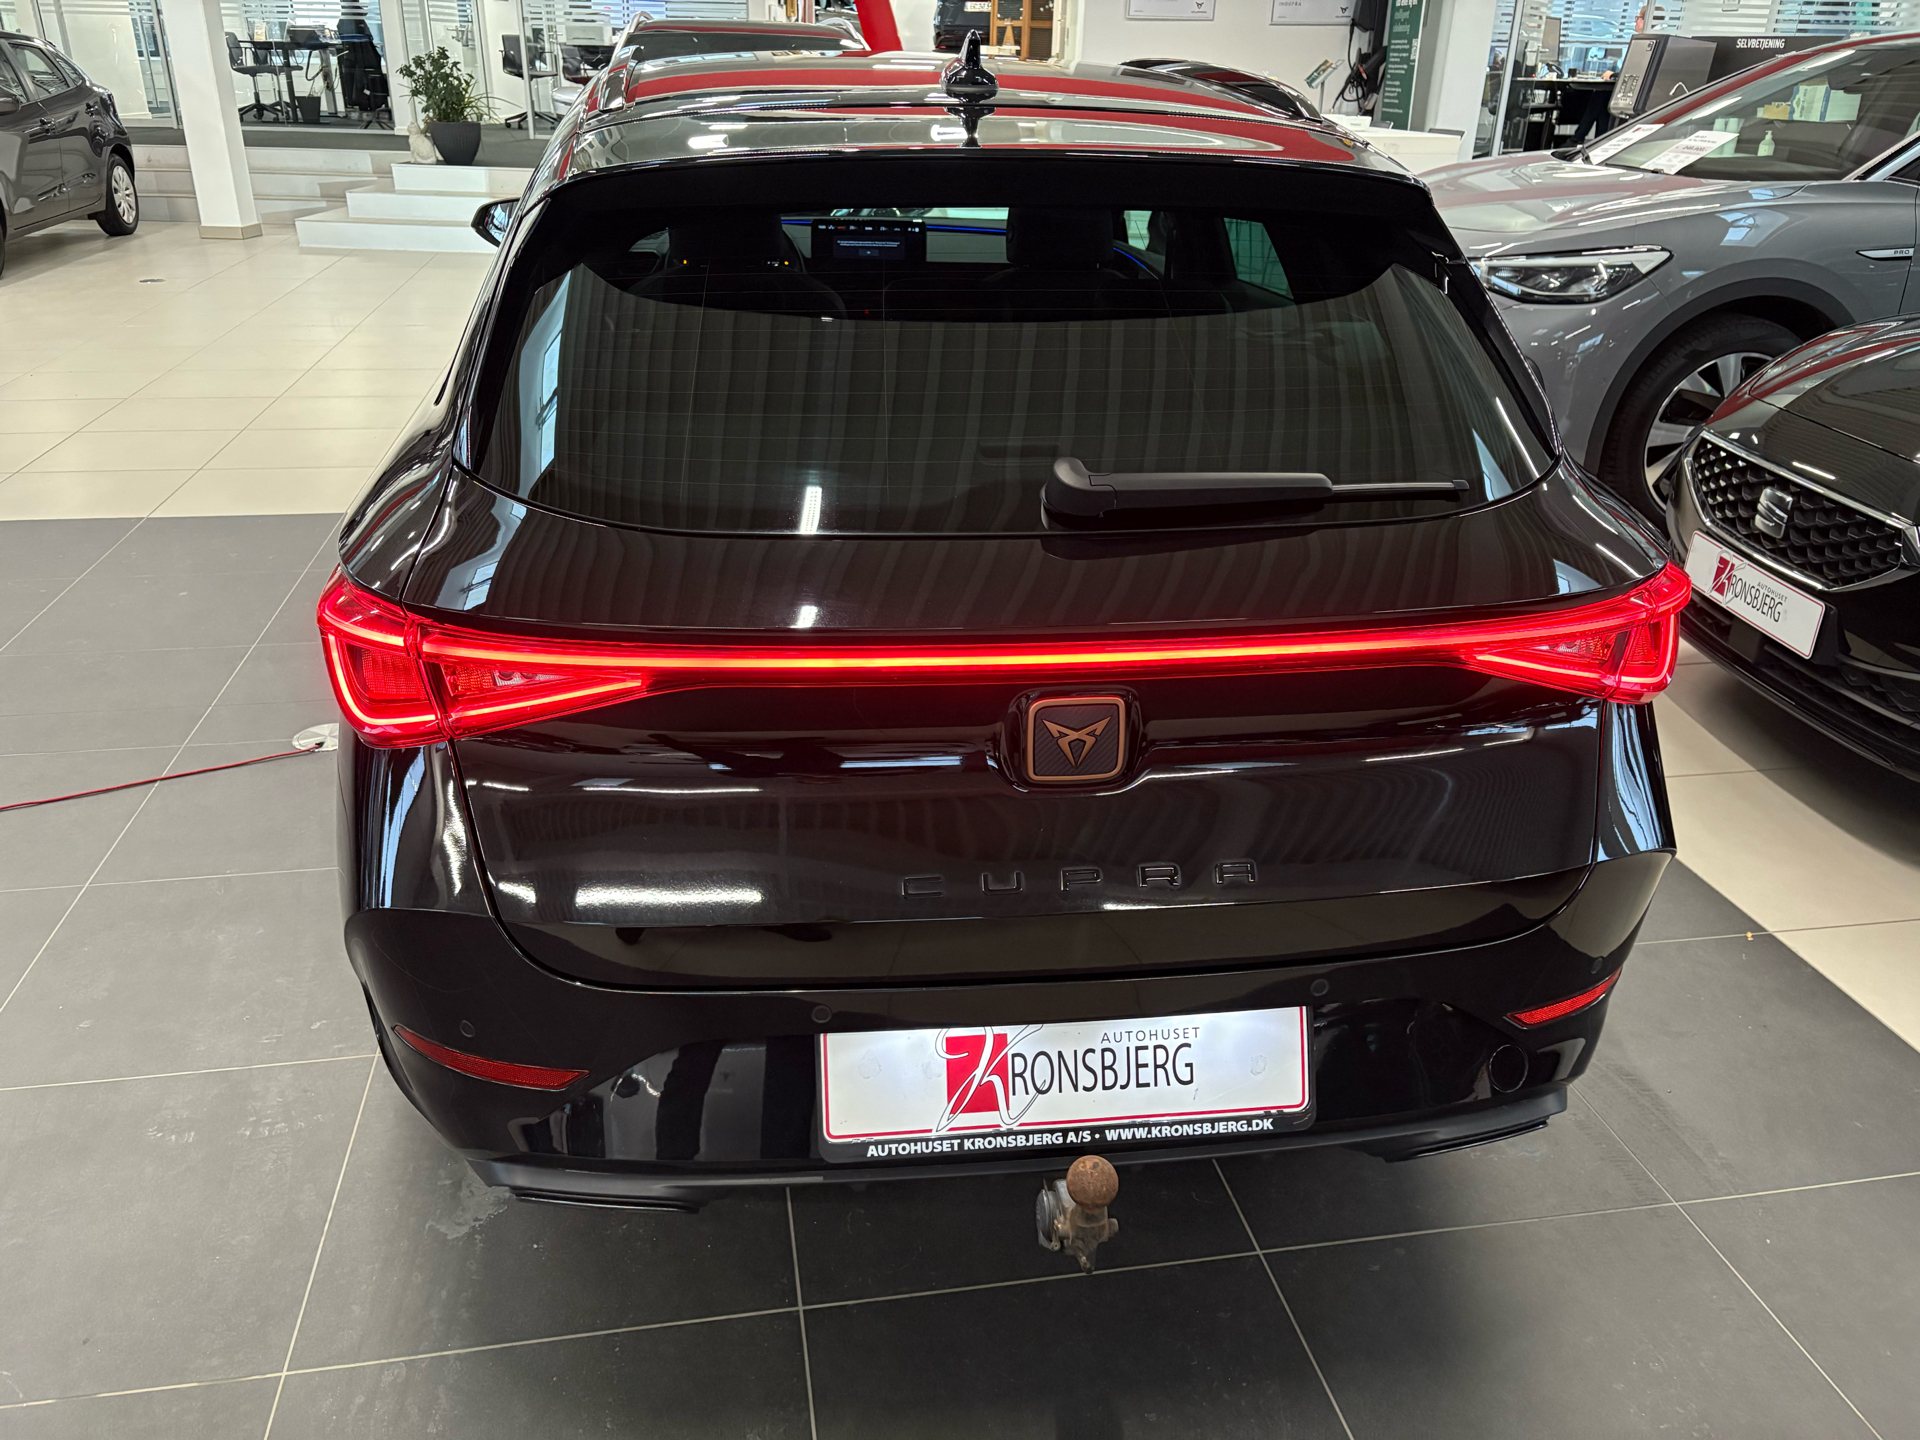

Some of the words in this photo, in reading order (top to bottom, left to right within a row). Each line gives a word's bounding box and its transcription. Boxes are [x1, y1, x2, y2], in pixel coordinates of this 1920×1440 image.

[1736, 38, 1786, 50] SELVBETJENING
[1757, 581, 1788, 603] AUTOHUSET
[902, 861, 1256, 899] CUPRA
[1100, 1026, 1200, 1044] AUTOHUSET
[867, 1138, 960, 1158] AUTOHUSET
[963, 1132, 1064, 1151] KRONSBJERG
[1066, 1130, 1092, 1145] A/S
[1105, 1118, 1274, 1143] WWW.KRONSBJERG.DK
